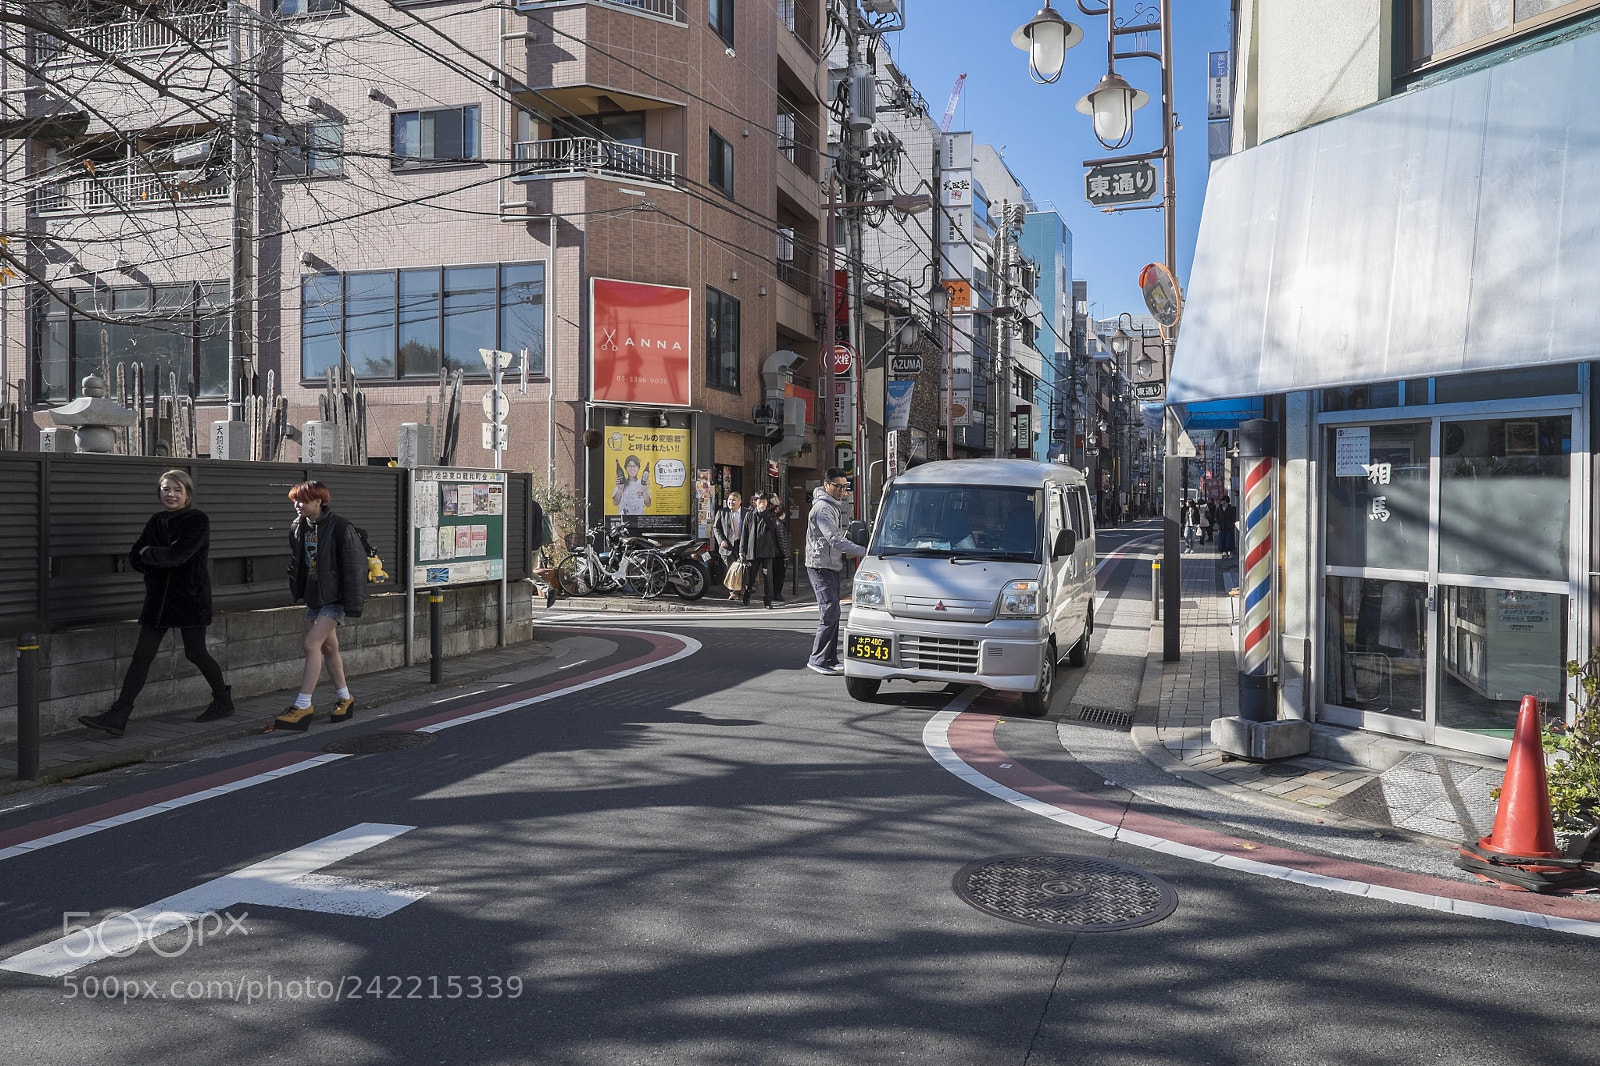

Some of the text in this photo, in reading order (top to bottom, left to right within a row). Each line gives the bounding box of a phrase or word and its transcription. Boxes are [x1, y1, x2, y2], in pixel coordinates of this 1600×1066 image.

[1088, 169, 1154, 198] 東通り
[624, 337, 682, 351] ANNA
[892, 358, 921, 370] AZUMA
[1367, 459, 1391, 522] 相馬
[856, 645, 889, 660] 59-43
